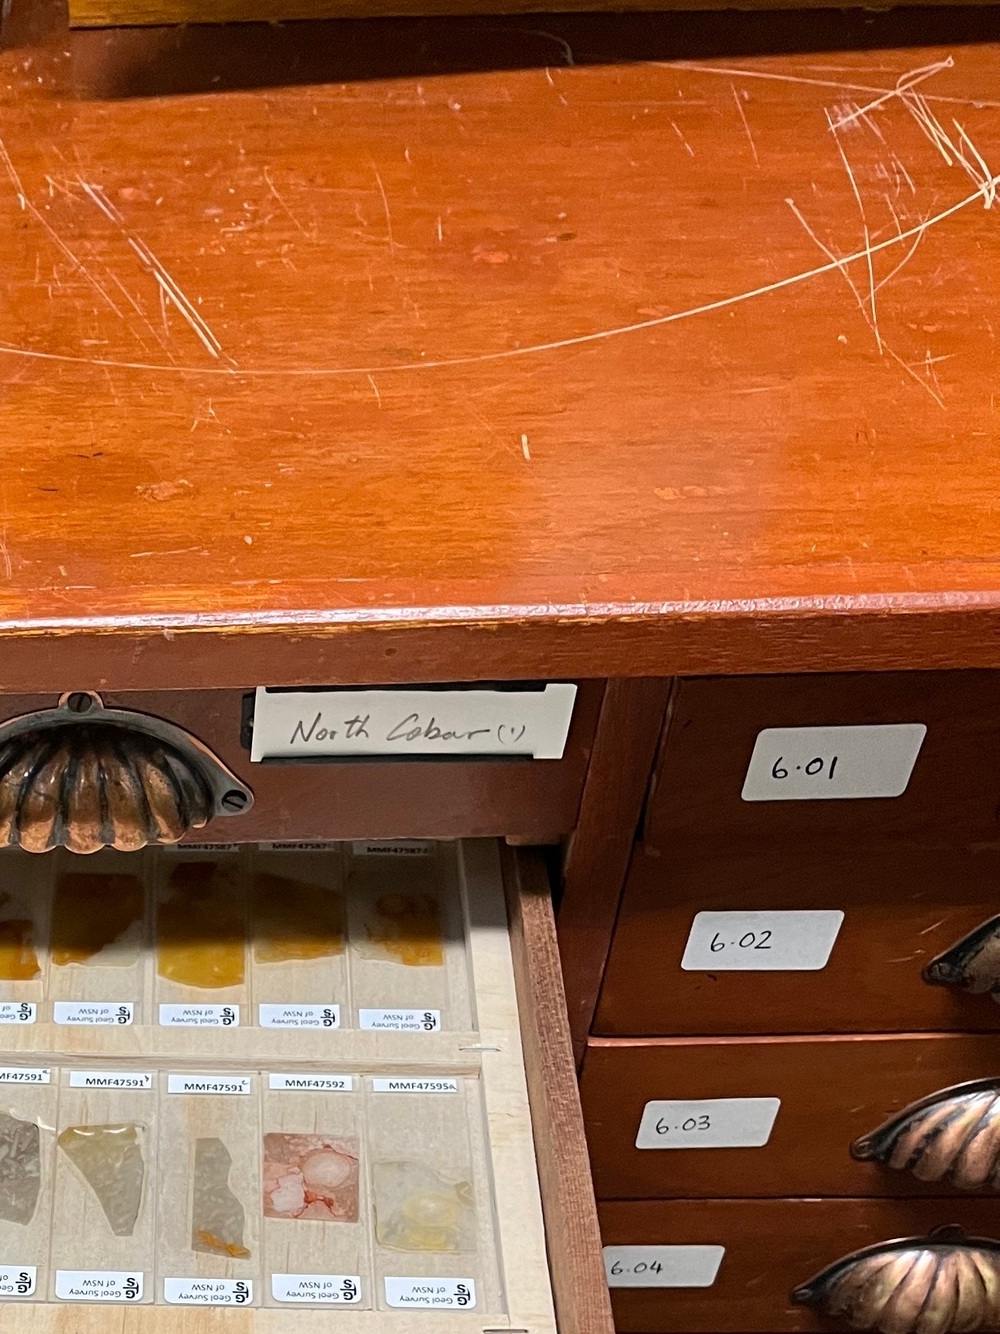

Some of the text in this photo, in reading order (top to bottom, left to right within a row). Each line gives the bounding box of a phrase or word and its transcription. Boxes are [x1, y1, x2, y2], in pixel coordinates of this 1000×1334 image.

[290, 712, 371, 744] North
[386, 713, 491, 742] Cobar
[285, 1080, 345, 1088] MMF47592
[82, 1279, 116, 1288] of NSW
[191, 1284, 225, 1292] of NSW
[298, 1281, 333, 1290] of NSW
[68, 1288, 122, 1298] Geol Survey
[286, 1290, 340, 1300] Geol Survey
[412, 1286, 446, 1295] of NSW
[178, 1293, 232, 1303] Geol Survey
[399, 1295, 454, 1305] Geol Survey
